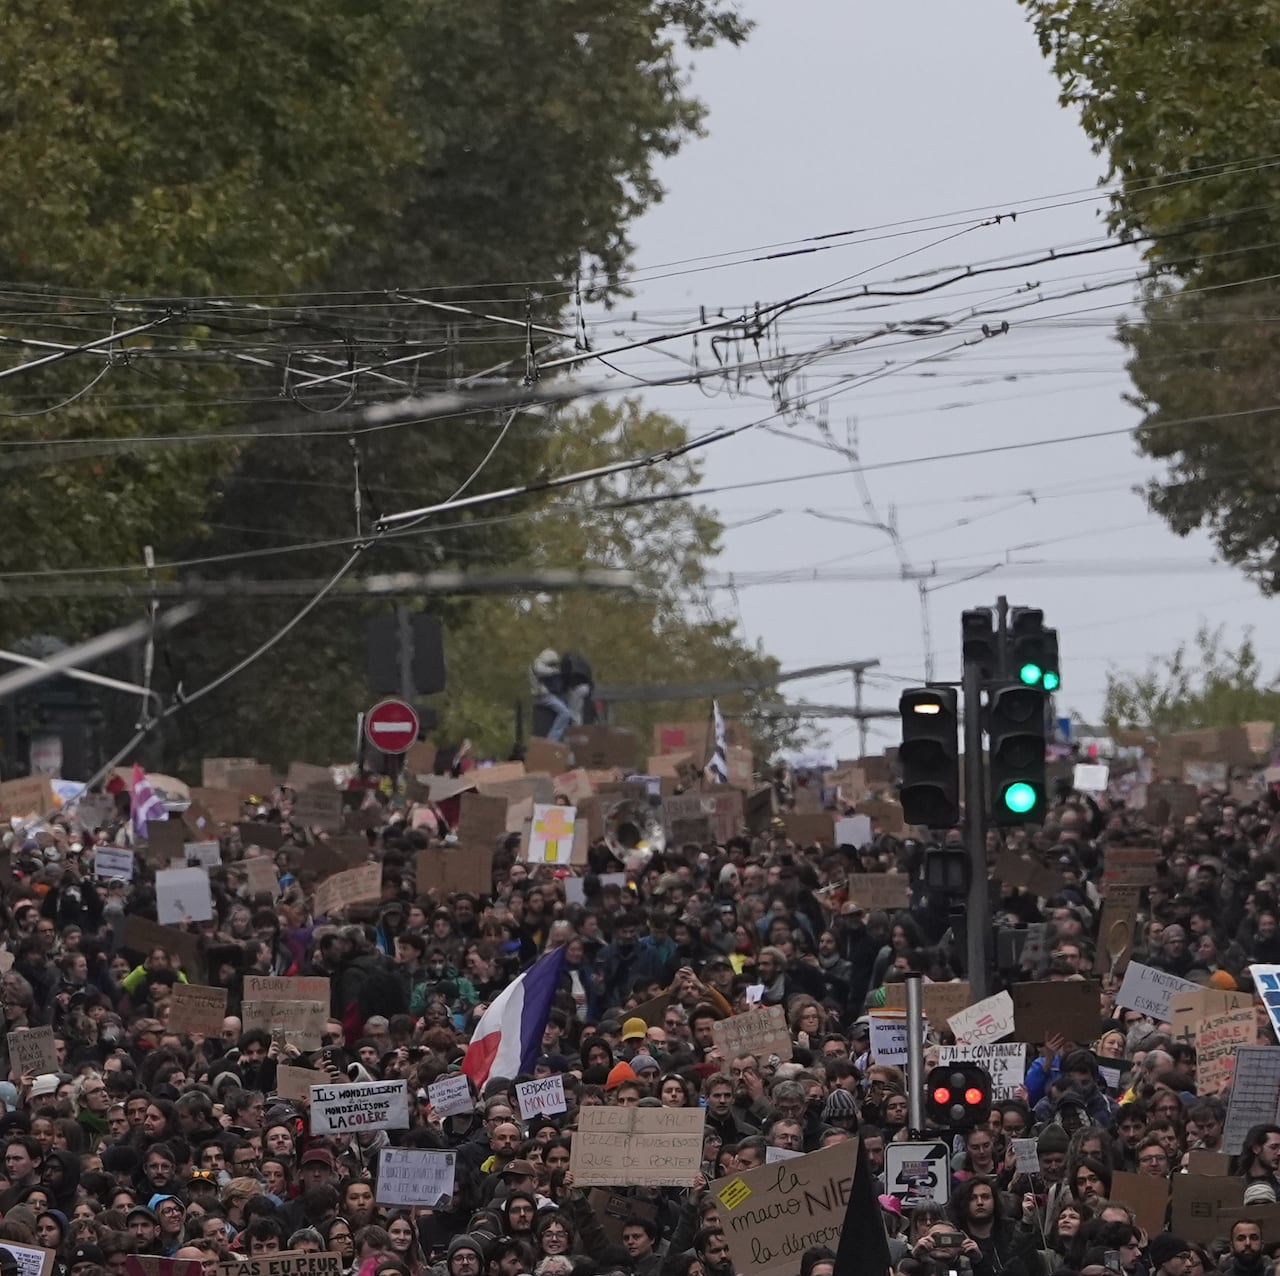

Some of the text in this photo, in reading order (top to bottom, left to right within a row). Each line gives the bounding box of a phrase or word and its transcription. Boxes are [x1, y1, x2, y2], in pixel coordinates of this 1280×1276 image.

[971, 1044, 1023, 1059] CONFIANCE
[547, 1092, 565, 1108] CUL
[329, 1110, 389, 1129] LA COLÈRE
[767, 1166, 810, 1195] la
[750, 1221, 844, 1265] la démocr
[220, 1257, 338, 1276] T'AS EU PEUR
